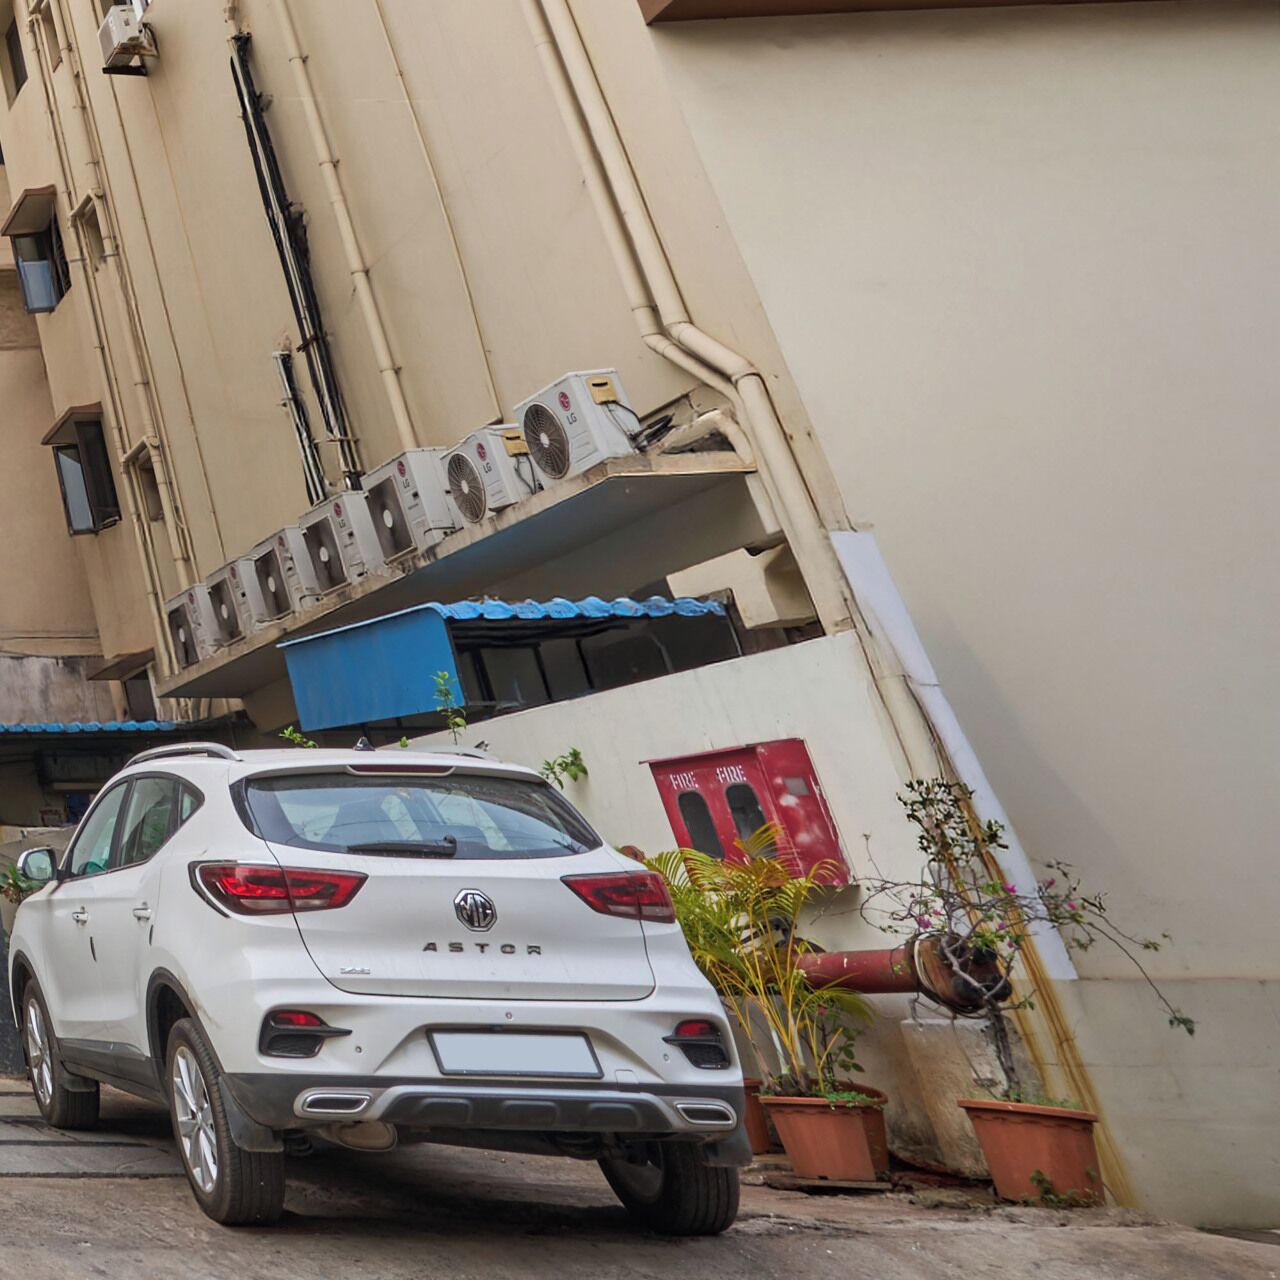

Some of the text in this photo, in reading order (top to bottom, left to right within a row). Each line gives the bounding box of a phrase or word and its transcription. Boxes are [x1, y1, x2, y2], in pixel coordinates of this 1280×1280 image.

[566, 412, 577, 425] LG
[483, 462, 492, 474] LG
[670, 771, 699, 790] FIRE
[716, 765, 747, 783] FIRE
[460, 893, 493, 927] MG
[422, 942, 542, 955] ASTOR
